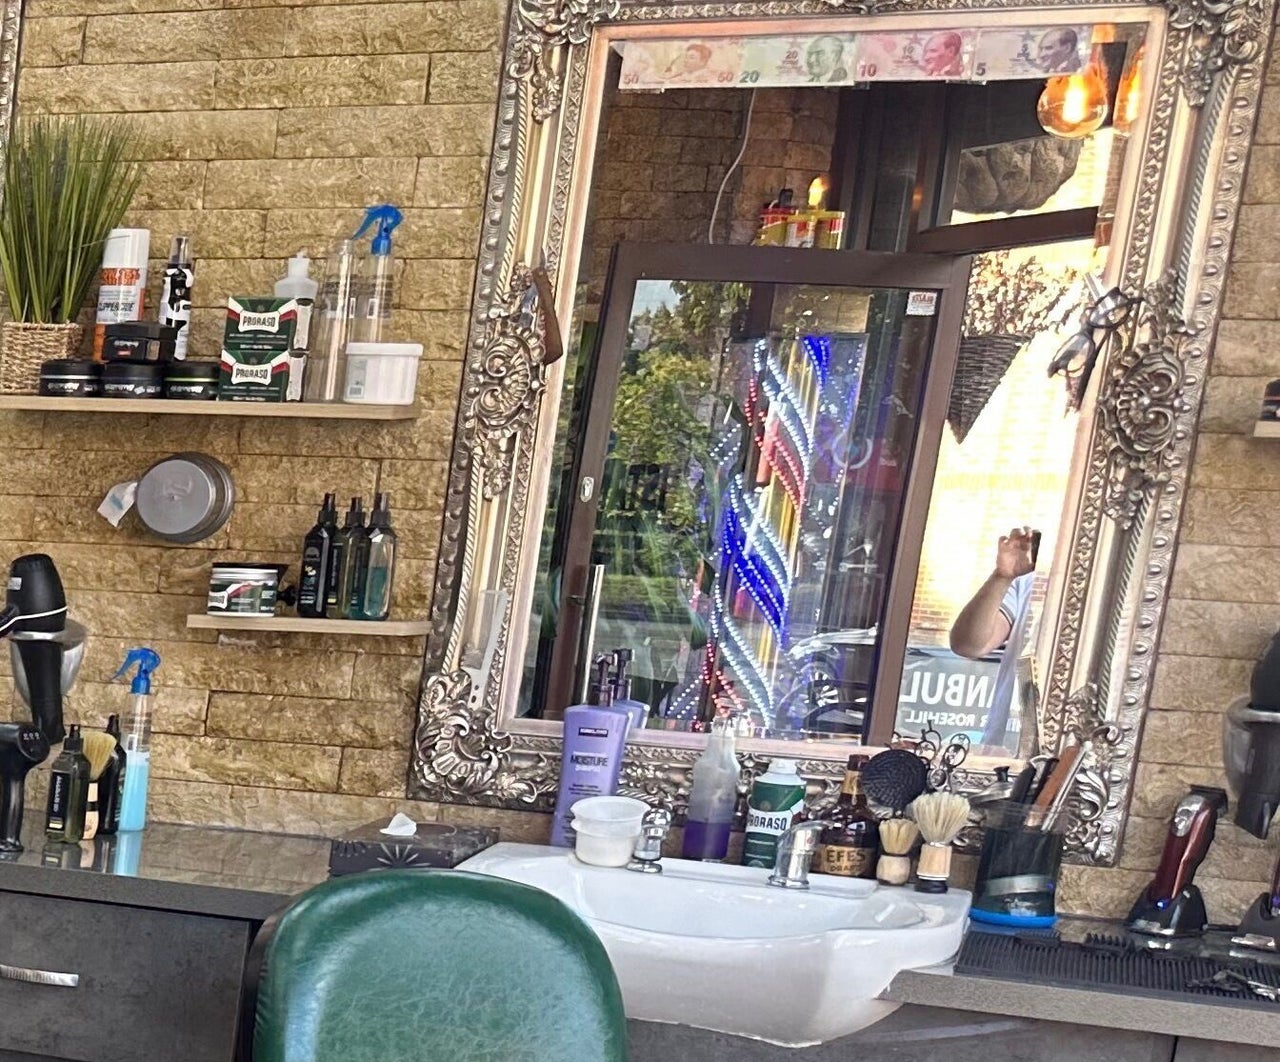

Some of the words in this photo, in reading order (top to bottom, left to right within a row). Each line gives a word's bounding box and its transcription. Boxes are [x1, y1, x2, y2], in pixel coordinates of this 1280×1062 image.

[859, 64, 877, 78] 10
[975, 62, 987, 77] 5
[740, 70, 759, 84] 20
[242, 315, 276, 328] PRORASO
[235, 367, 268, 380] PRORASO
[570, 755, 609, 767] MOISTURE
[749, 814, 787, 831] RORASO
[826, 849, 866, 862] EFES
